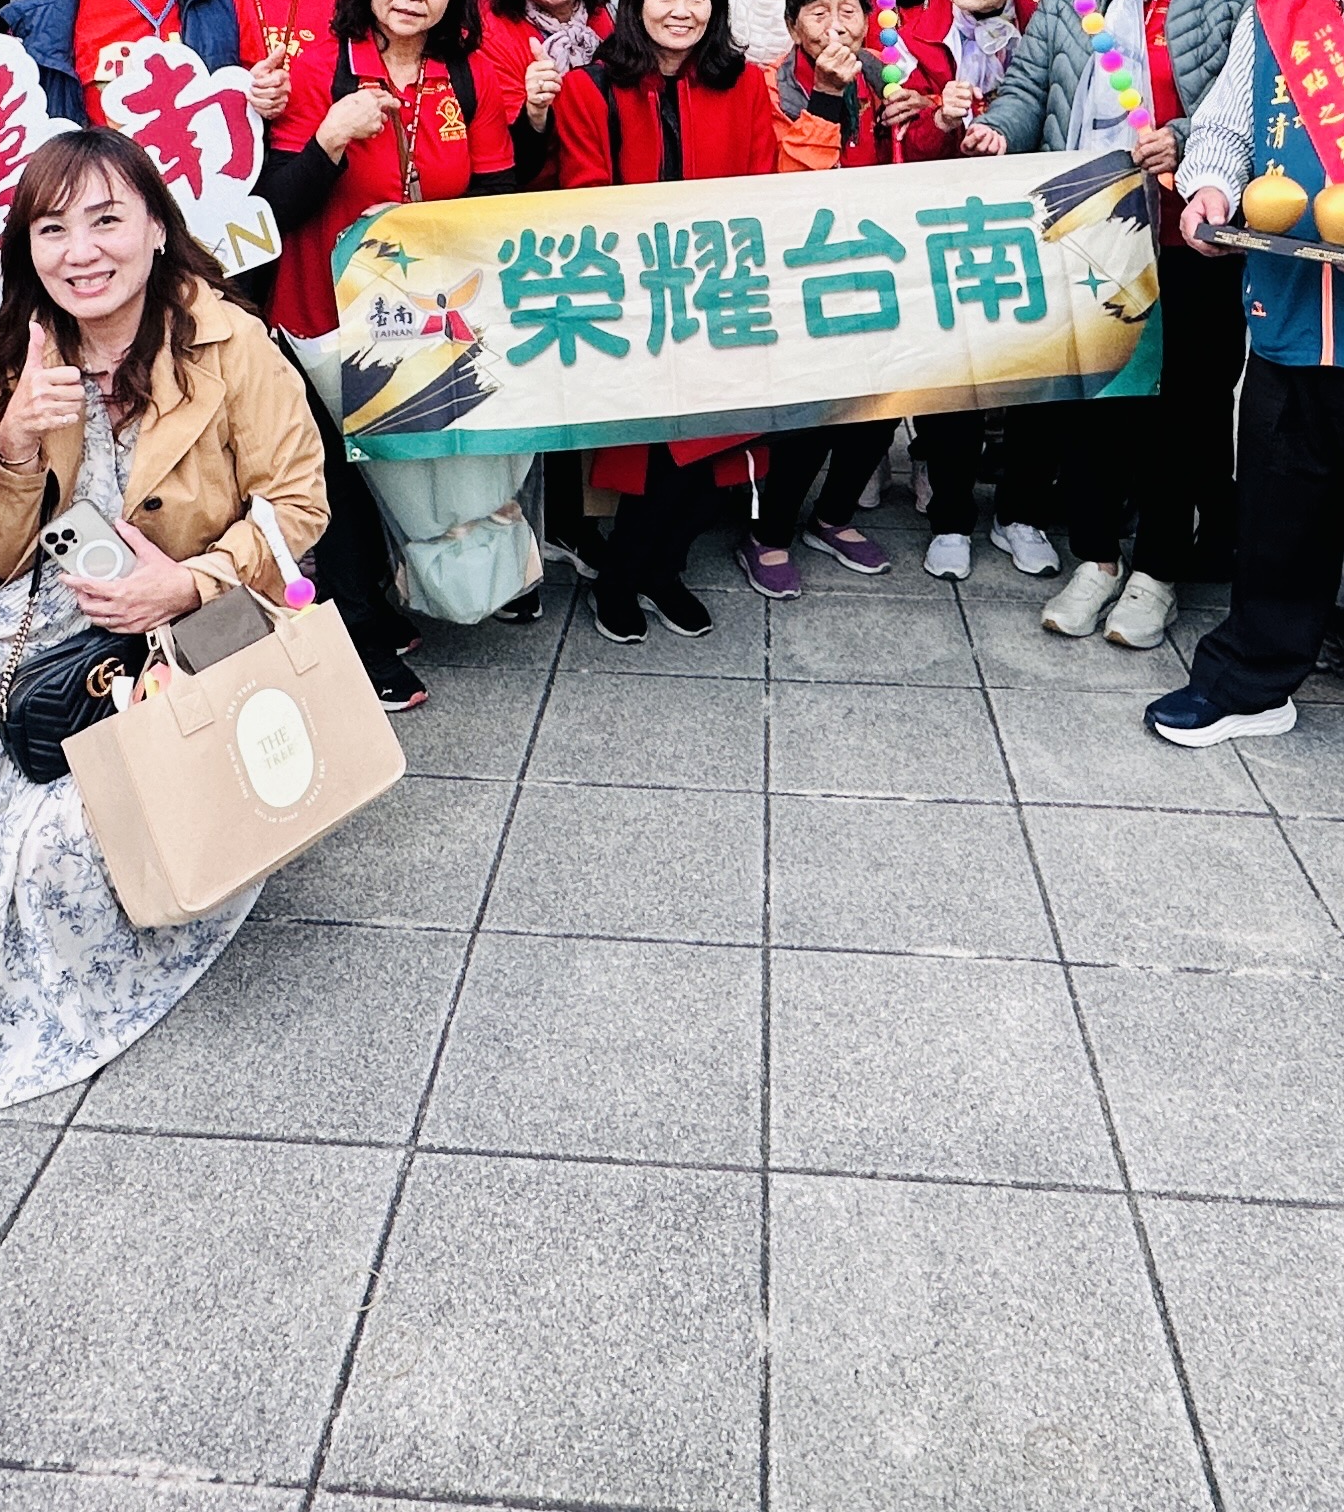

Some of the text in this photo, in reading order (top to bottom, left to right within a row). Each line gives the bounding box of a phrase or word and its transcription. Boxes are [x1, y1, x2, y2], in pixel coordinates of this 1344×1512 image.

[497, 195, 1048, 368] 榮耀台南
[369, 296, 413, 327] 臺南
[374, 329, 414, 339] TAINAN
[257, 725, 290, 756] THE
